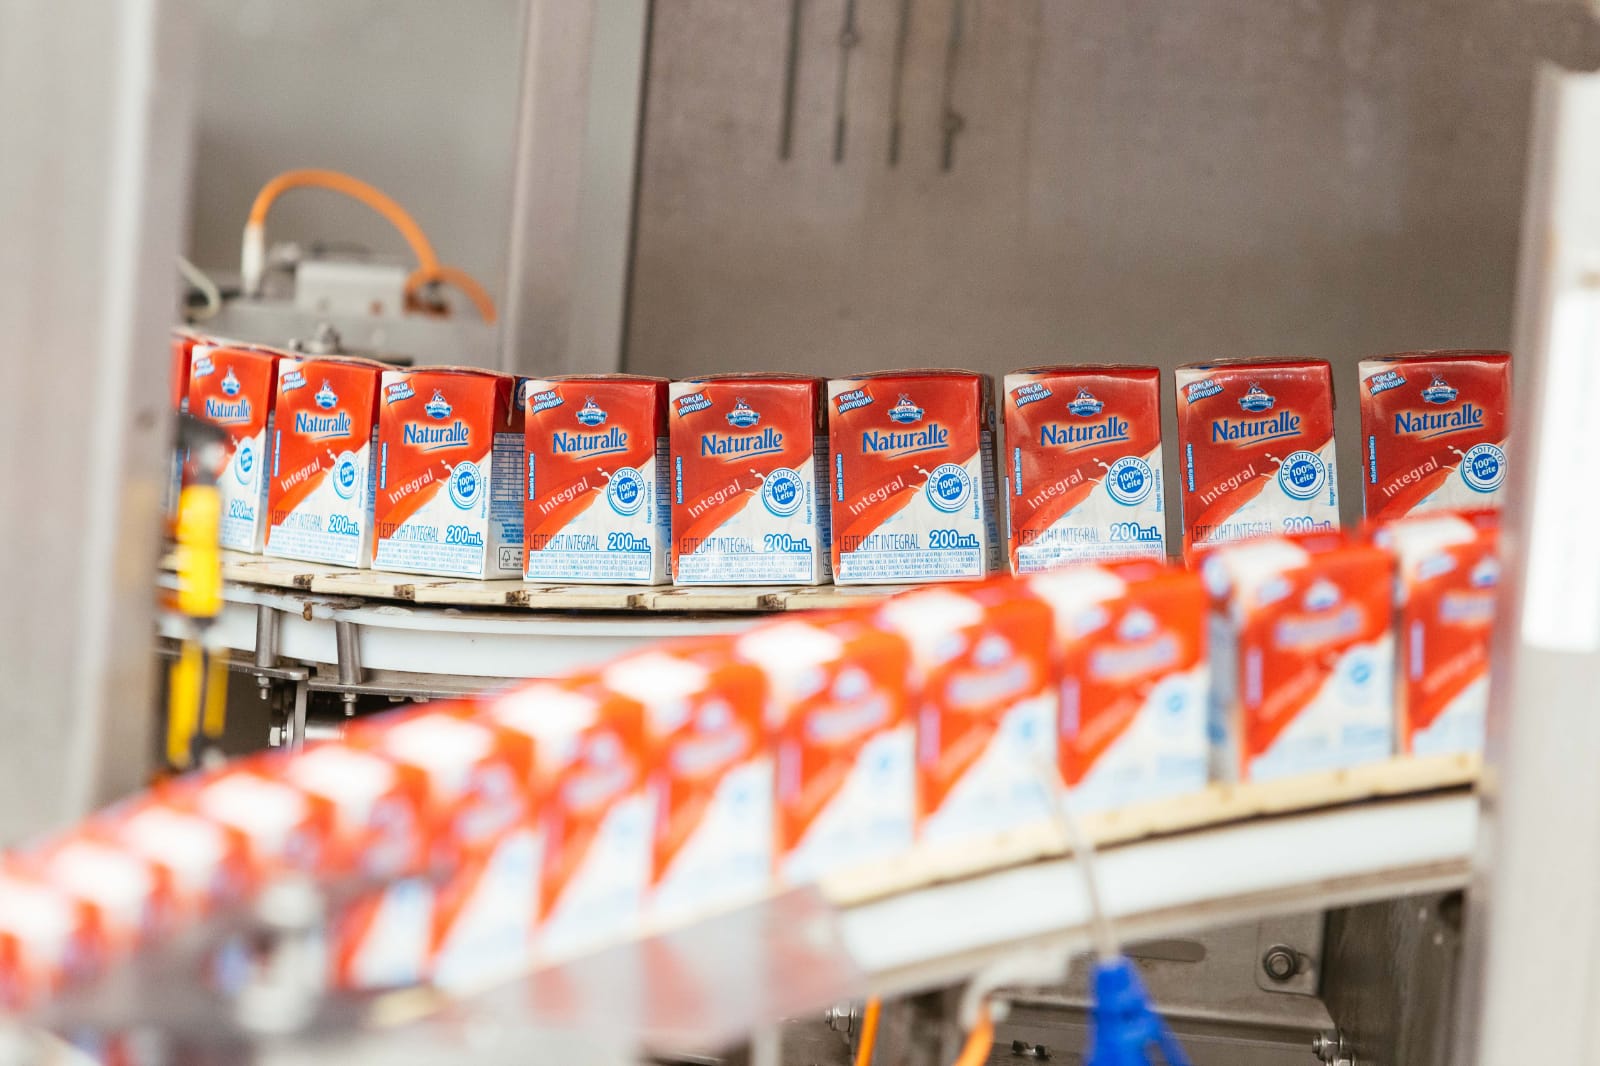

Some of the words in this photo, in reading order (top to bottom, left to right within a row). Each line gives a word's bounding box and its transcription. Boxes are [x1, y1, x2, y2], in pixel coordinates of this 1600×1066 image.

[1187, 386, 1223, 403] INDIVIDUAL
[1371, 377, 1406, 395] INDIVIDUAL
[206, 398, 251, 418] Naturalle
[679, 399, 712, 416] INDIVIDUAL
[838, 395, 873, 413] INDIVIDUAL
[1016, 389, 1052, 407] INDIVIDUAL
[296, 411, 350, 433] Naturalle
[1212, 411, 1300, 442] Naturalle
[1395, 403, 1483, 435] Naturalle
[404, 422, 469, 444] Naturalle
[553, 428, 628, 453] Naturalle
[863, 424, 948, 452] Naturalle
[1041, 416, 1129, 446] Naturalle
[702, 428, 783, 457] Naturalle
[1118, 459, 1150, 480] ADITIVOS
[1290, 453, 1322, 474] ADITIVOS
[1292, 464, 1312, 476] 100%
[1474, 456, 1495, 469] 100%
[1476, 466, 1496, 478] Leite
[281, 458, 320, 492] Integral
[617, 468, 644, 492] ADITIVOS
[772, 470, 802, 492] ADITIVOS
[938, 467, 969, 487] ADITIVOS
[939, 477, 960, 489] 100%
[1119, 469, 1141, 482] 100%
[1122, 478, 1142, 490] Leite
[1200, 464, 1256, 506] Integral
[1295, 473, 1315, 484] Leite
[1382, 456, 1438, 497] Integral
[389, 469, 433, 504] Integral
[539, 477, 589, 514] Integral
[619, 480, 636, 492] 100%
[620, 489, 636, 500] Leite
[774, 481, 793, 494] 100%
[776, 490, 794, 501] Leite
[849, 475, 904, 516] Integral
[942, 486, 960, 497] Leite
[1027, 469, 1083, 509] Integral
[688, 480, 741, 518] Integral
[328, 514, 359, 535] 200mL
[380, 523, 396, 539] LEITE
[396, 524, 409, 540] UHT
[410, 525, 439, 542] INTEGRAL
[1111, 522, 1161, 542] 200mL
[446, 525, 482, 545] 200mL
[530, 534, 549, 550] LEITE
[550, 534, 564, 550] UHT
[565, 534, 599, 550] INTEGRAL
[608, 532, 651, 551] 200mL
[679, 538, 699, 553] LEITE
[700, 538, 717, 553] UHT
[718, 537, 755, 553] INTEGRAL
[764, 534, 811, 552] 200mL
[840, 535, 860, 552] LEITE
[863, 535, 879, 550] UHT
[881, 534, 920, 550] INTEGRAL
[929, 530, 980, 549] 200mL
